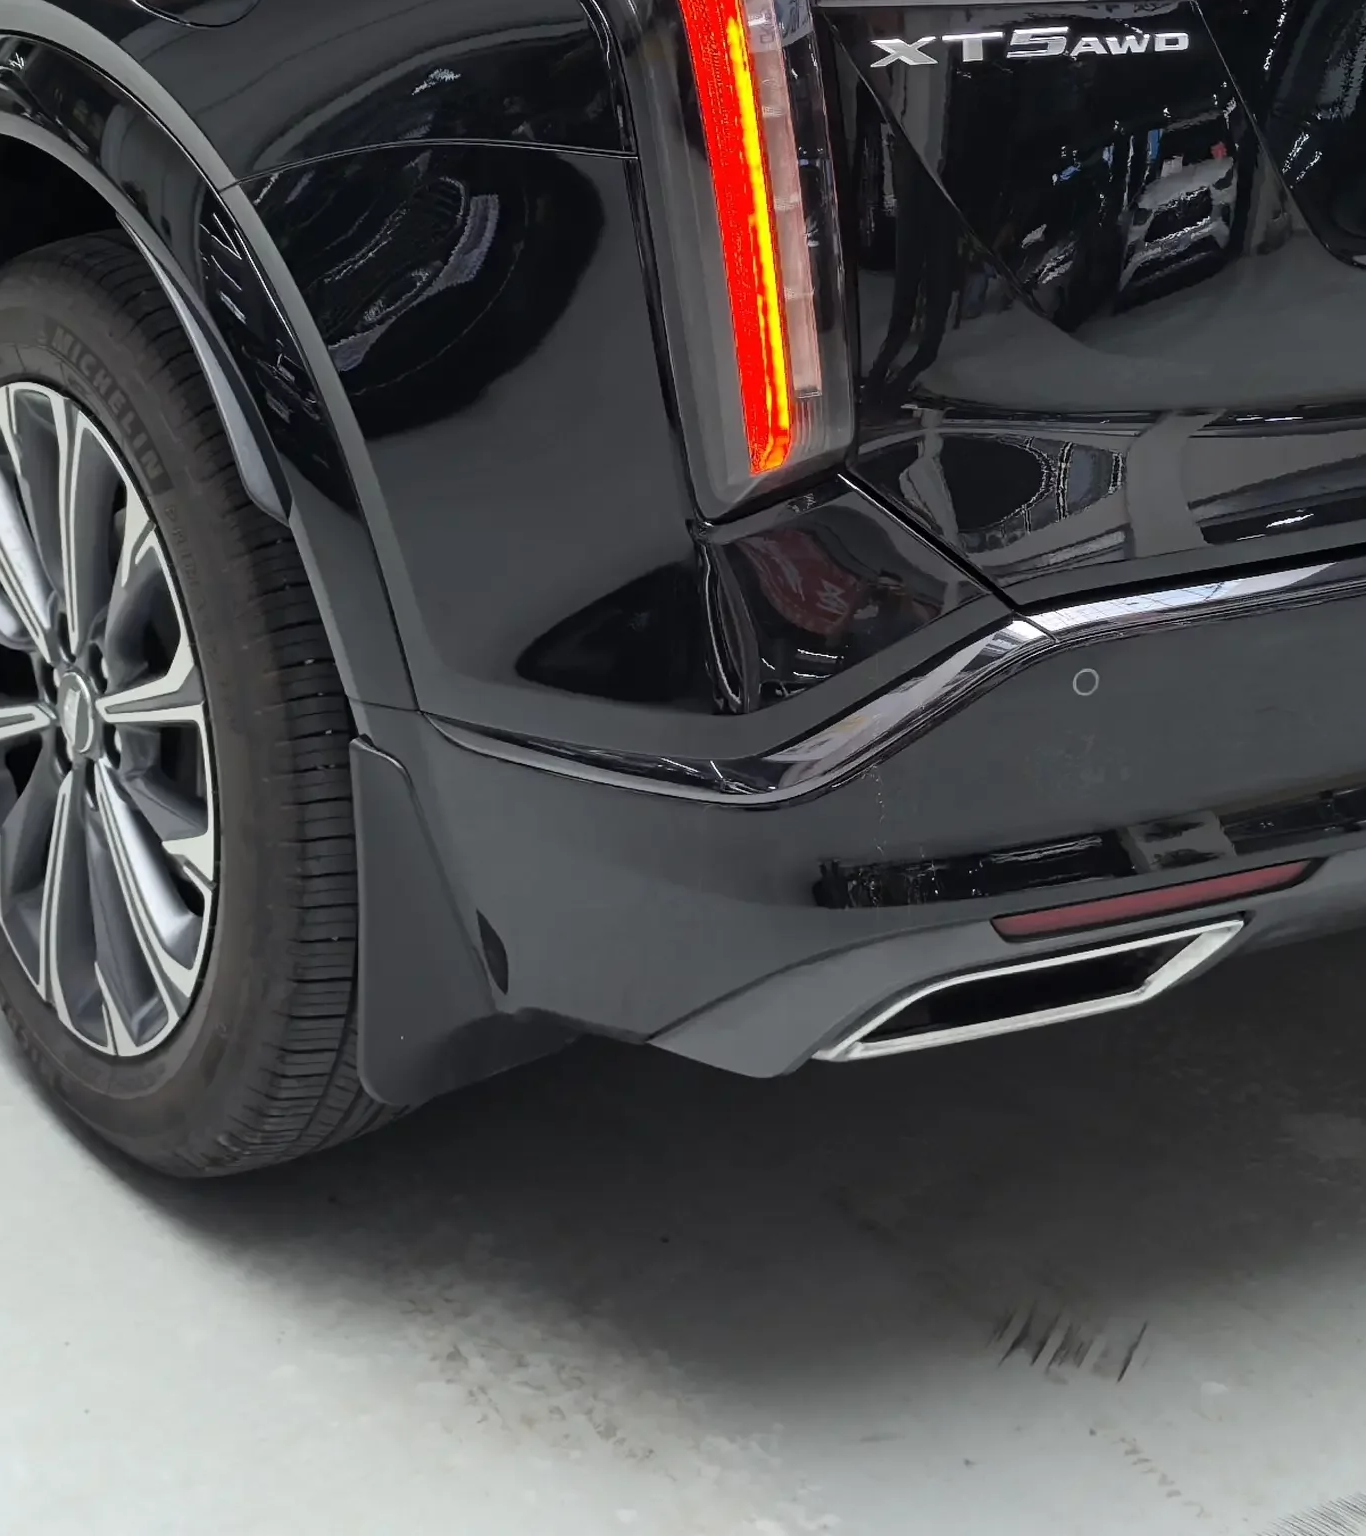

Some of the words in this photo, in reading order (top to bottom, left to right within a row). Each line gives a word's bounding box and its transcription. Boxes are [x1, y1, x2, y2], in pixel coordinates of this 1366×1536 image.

[870, 26, 1069, 68] XT5
[1070, 32, 1189, 56] AWD
[51, 325, 164, 480] MICHELIN
